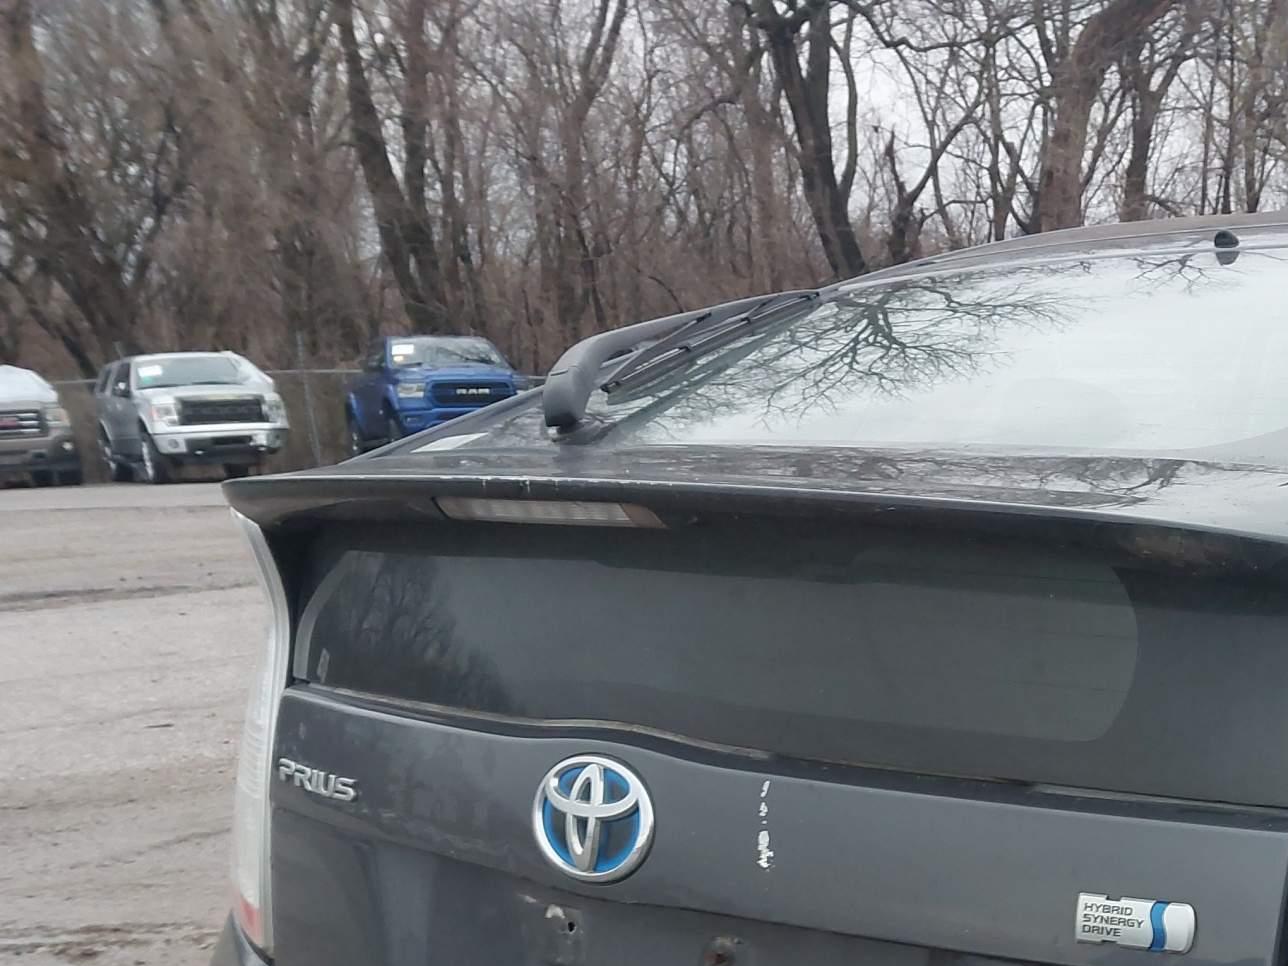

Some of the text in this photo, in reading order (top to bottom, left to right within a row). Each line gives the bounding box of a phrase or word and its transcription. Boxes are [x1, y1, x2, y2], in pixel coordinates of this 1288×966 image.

[279, 758, 357, 801] PRIUS
[1084, 902, 1133, 916] HYBRID
[1083, 913, 1144, 928] SYNERGY
[1082, 924, 1121, 937] DRIVE
